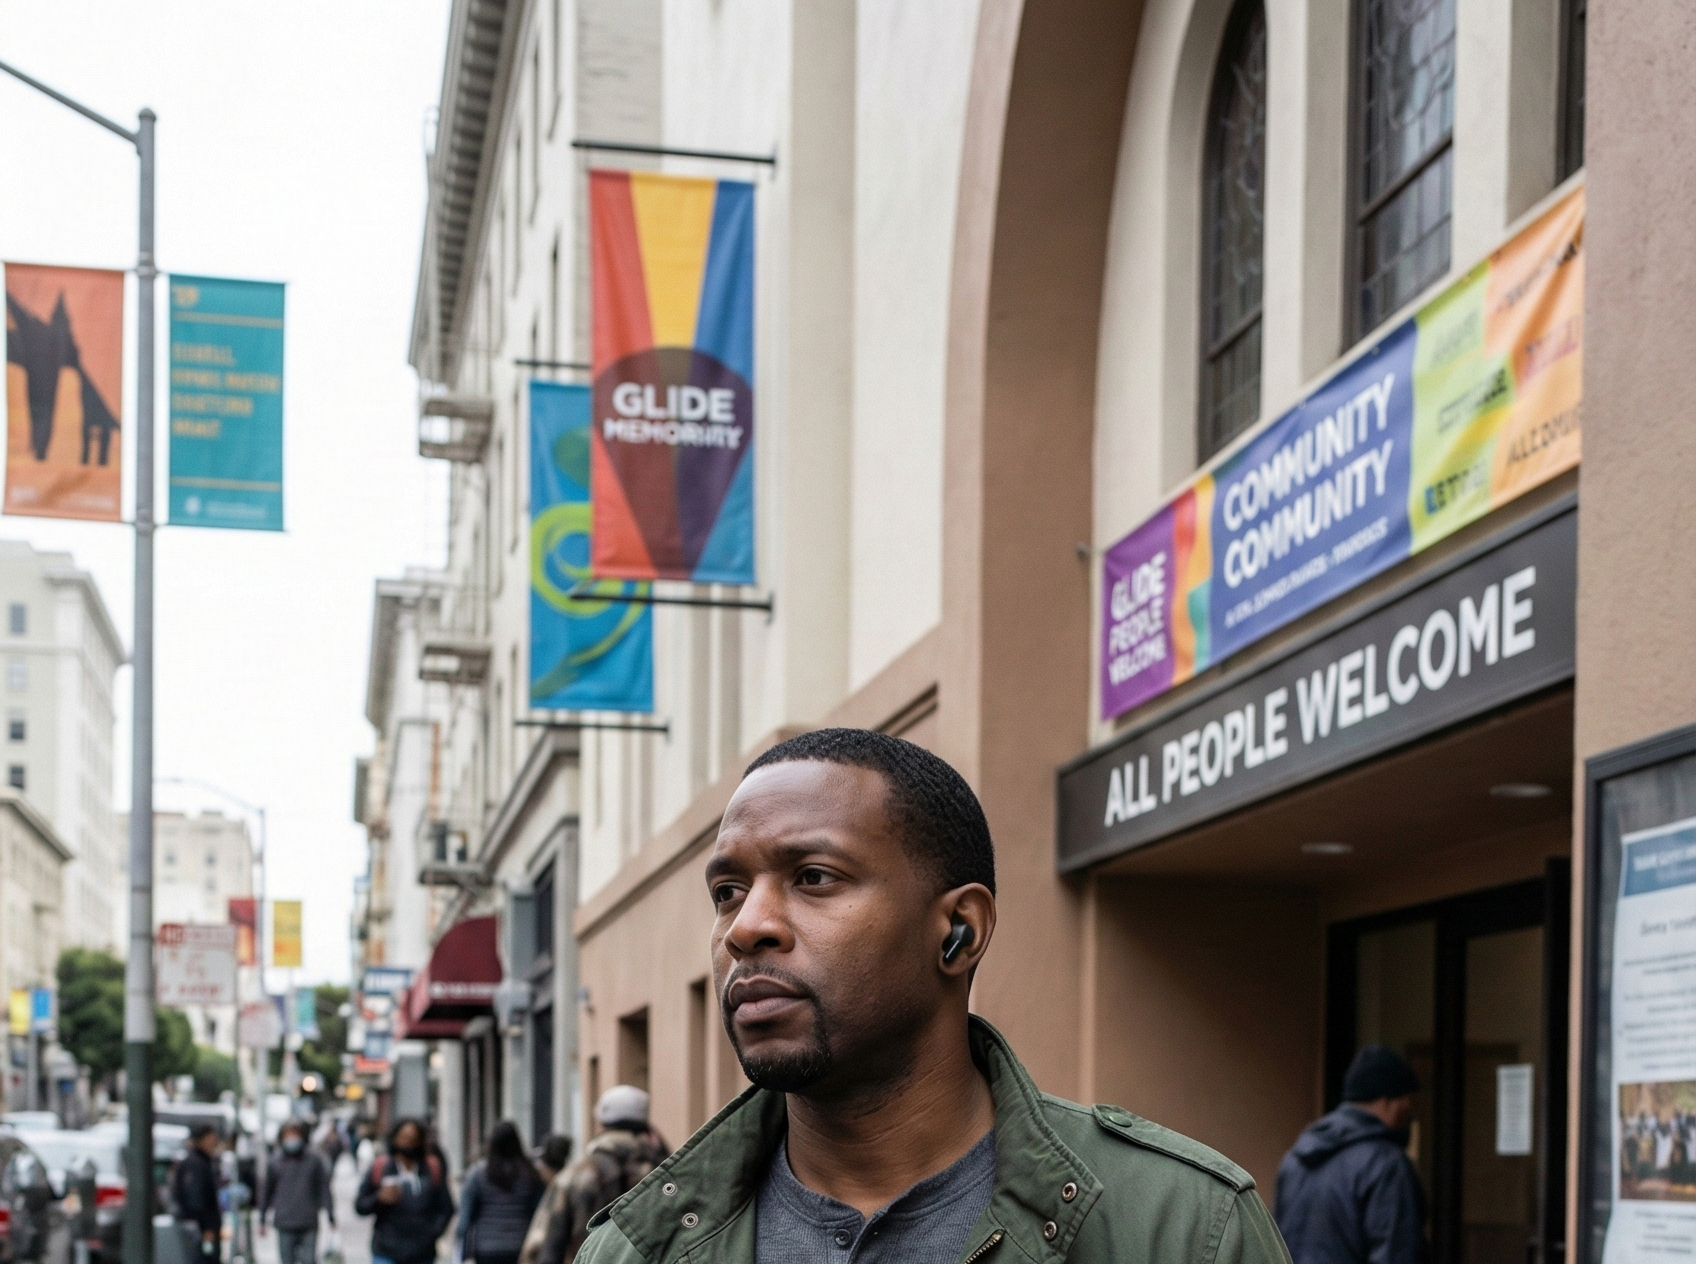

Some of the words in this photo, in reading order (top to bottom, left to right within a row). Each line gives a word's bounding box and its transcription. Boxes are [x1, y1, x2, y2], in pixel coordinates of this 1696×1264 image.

[612, 381, 736, 424] GLIDE
[1223, 372, 1396, 532] COMMUNITY
[1110, 551, 1168, 622] GLIDE
[1223, 438, 1395, 588] COMMUNITY
[1103, 753, 1158, 828] ALL
[1162, 686, 1289, 803] PEOPLE
[1296, 565, 1537, 746] WELCOME
